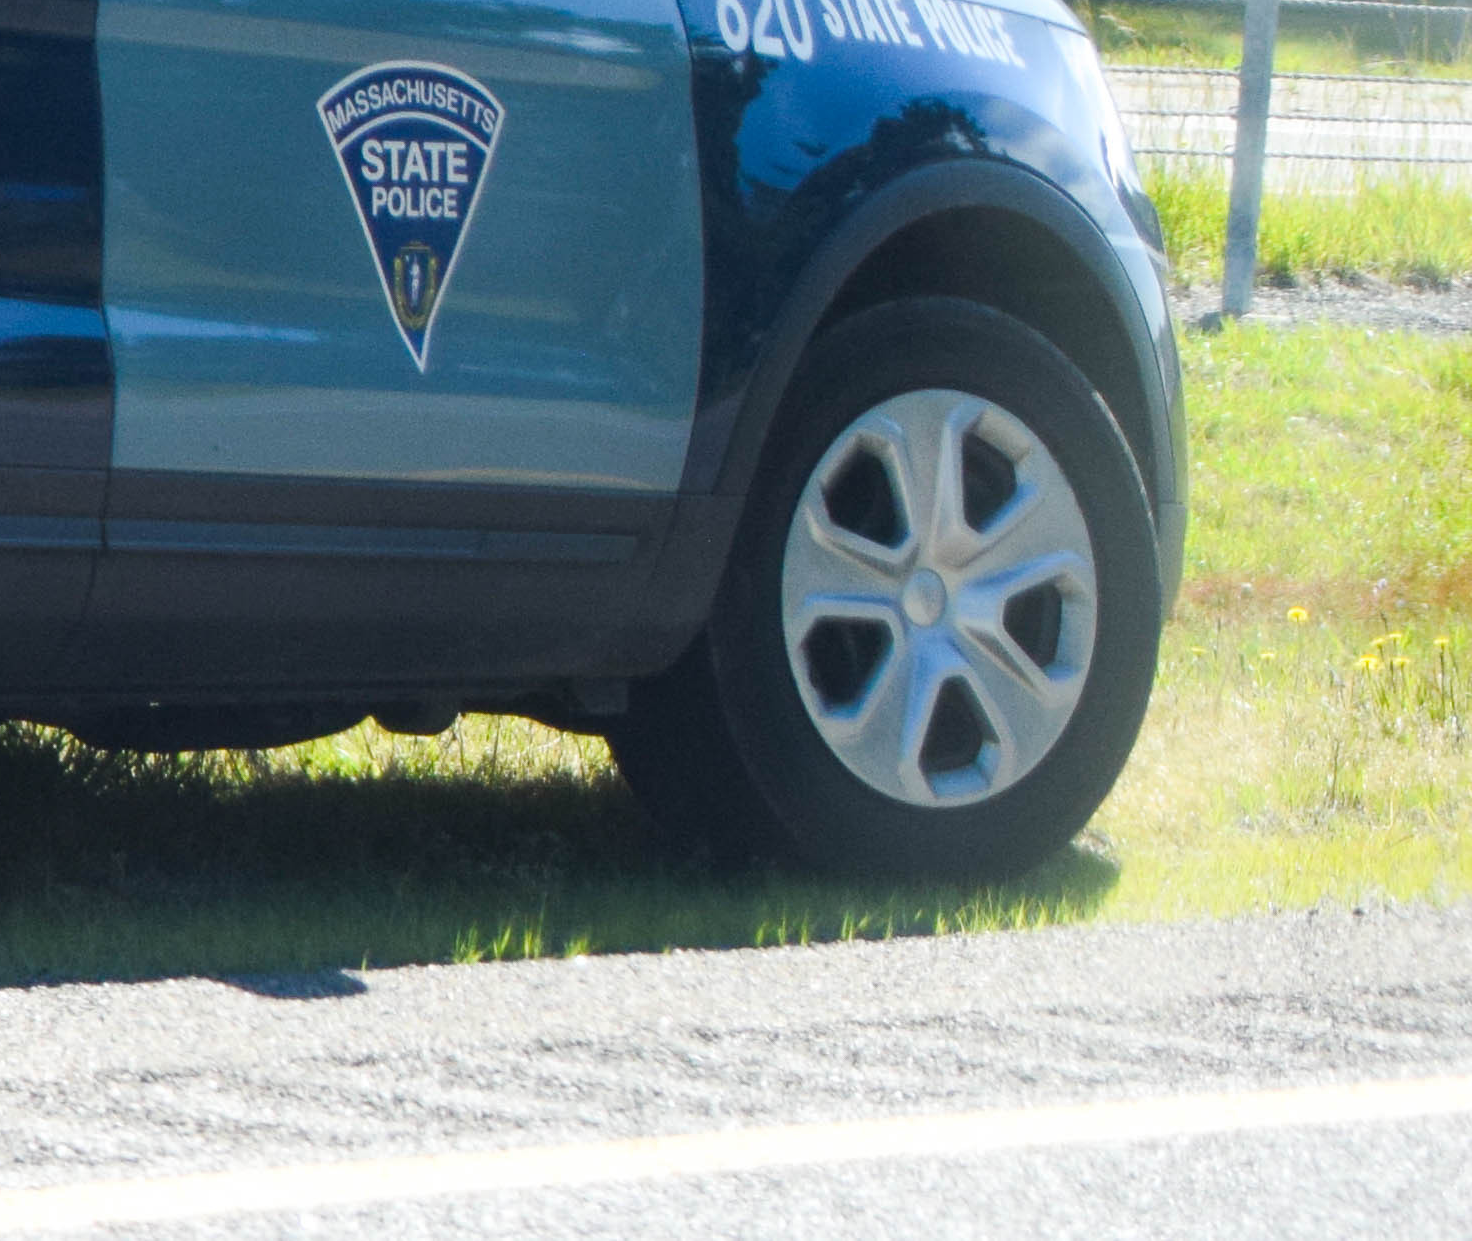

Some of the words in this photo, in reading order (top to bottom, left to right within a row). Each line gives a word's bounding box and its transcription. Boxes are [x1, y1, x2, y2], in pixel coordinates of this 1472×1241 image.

[326, 78, 496, 134] MASSACHUSETTS
[361, 139, 469, 184] STATE
[372, 186, 458, 218] POLICE
